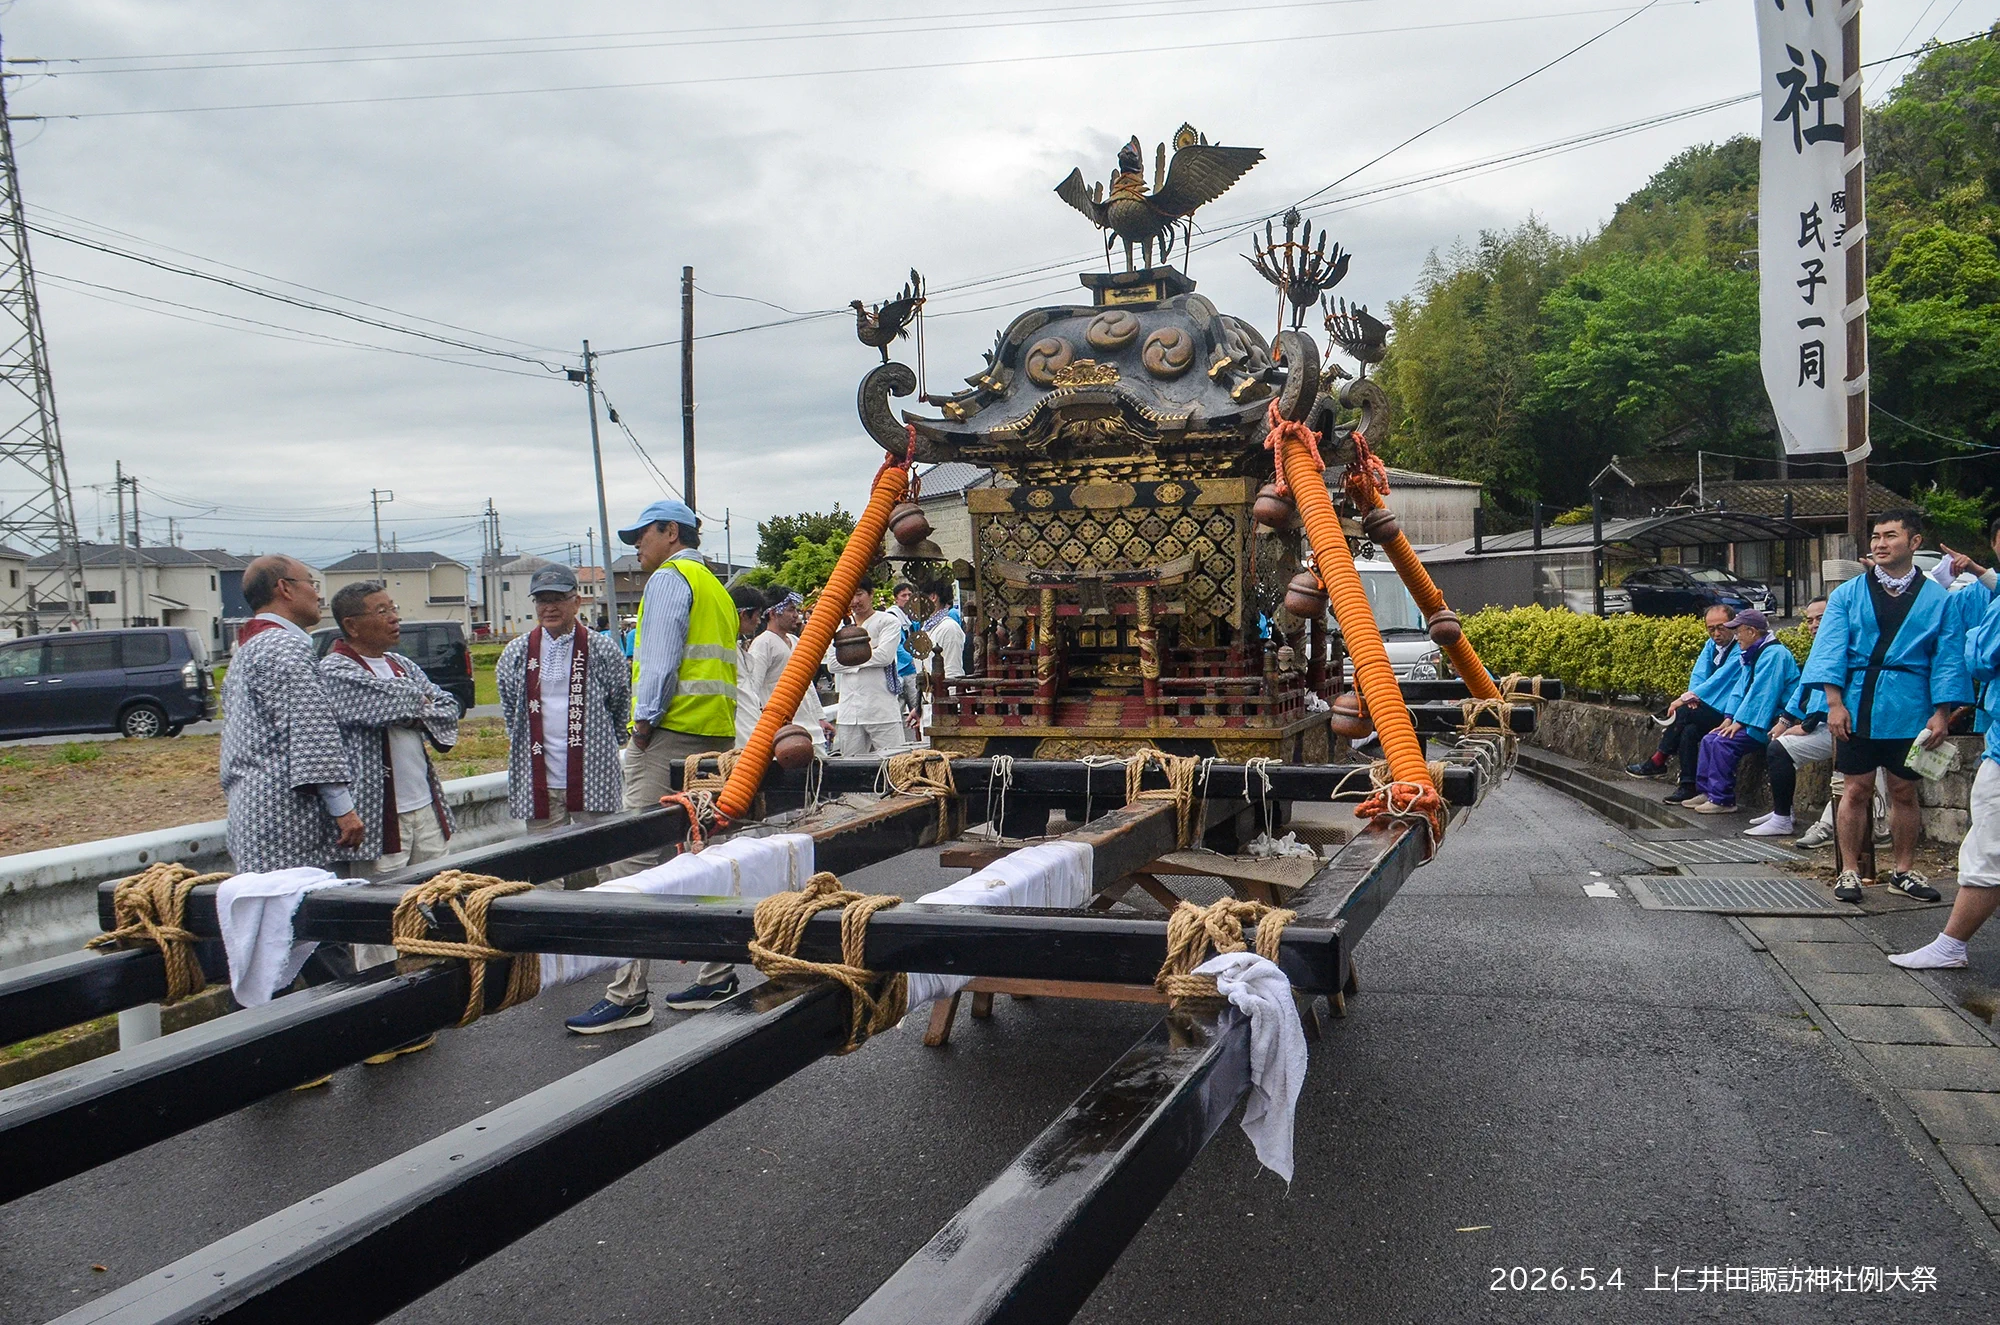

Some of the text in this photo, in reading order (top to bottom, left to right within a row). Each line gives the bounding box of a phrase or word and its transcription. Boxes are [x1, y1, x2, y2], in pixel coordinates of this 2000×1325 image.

[1773, 0, 1845, 155] 社
[1796, 201, 1827, 389] 氏子一同
[568, 649, 585, 748] 上仁井田諏訪神社
[1900, 879, 1915, 891] N
